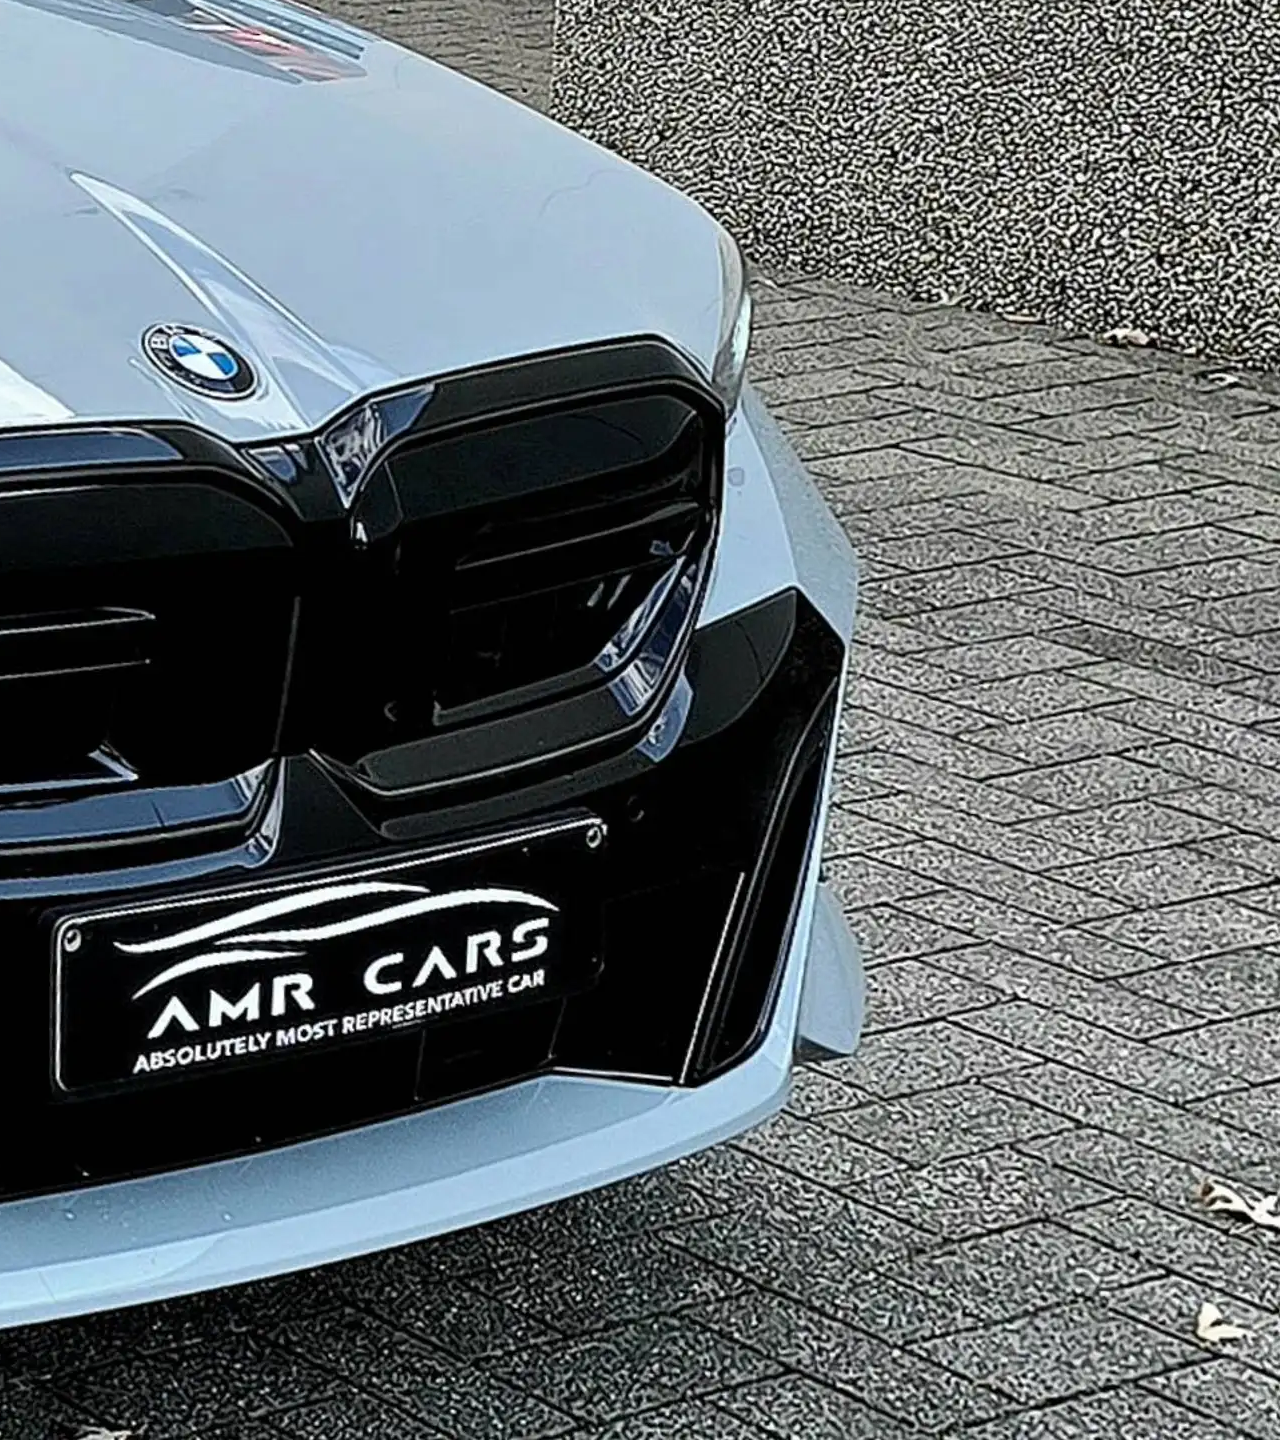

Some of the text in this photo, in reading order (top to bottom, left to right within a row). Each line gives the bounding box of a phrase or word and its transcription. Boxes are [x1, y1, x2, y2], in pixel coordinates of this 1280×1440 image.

[132, 968, 546, 1074] ABSOLUTELY MOST REPRESENTATIVE CAR
[146, 917, 550, 1039] AMR CARS
